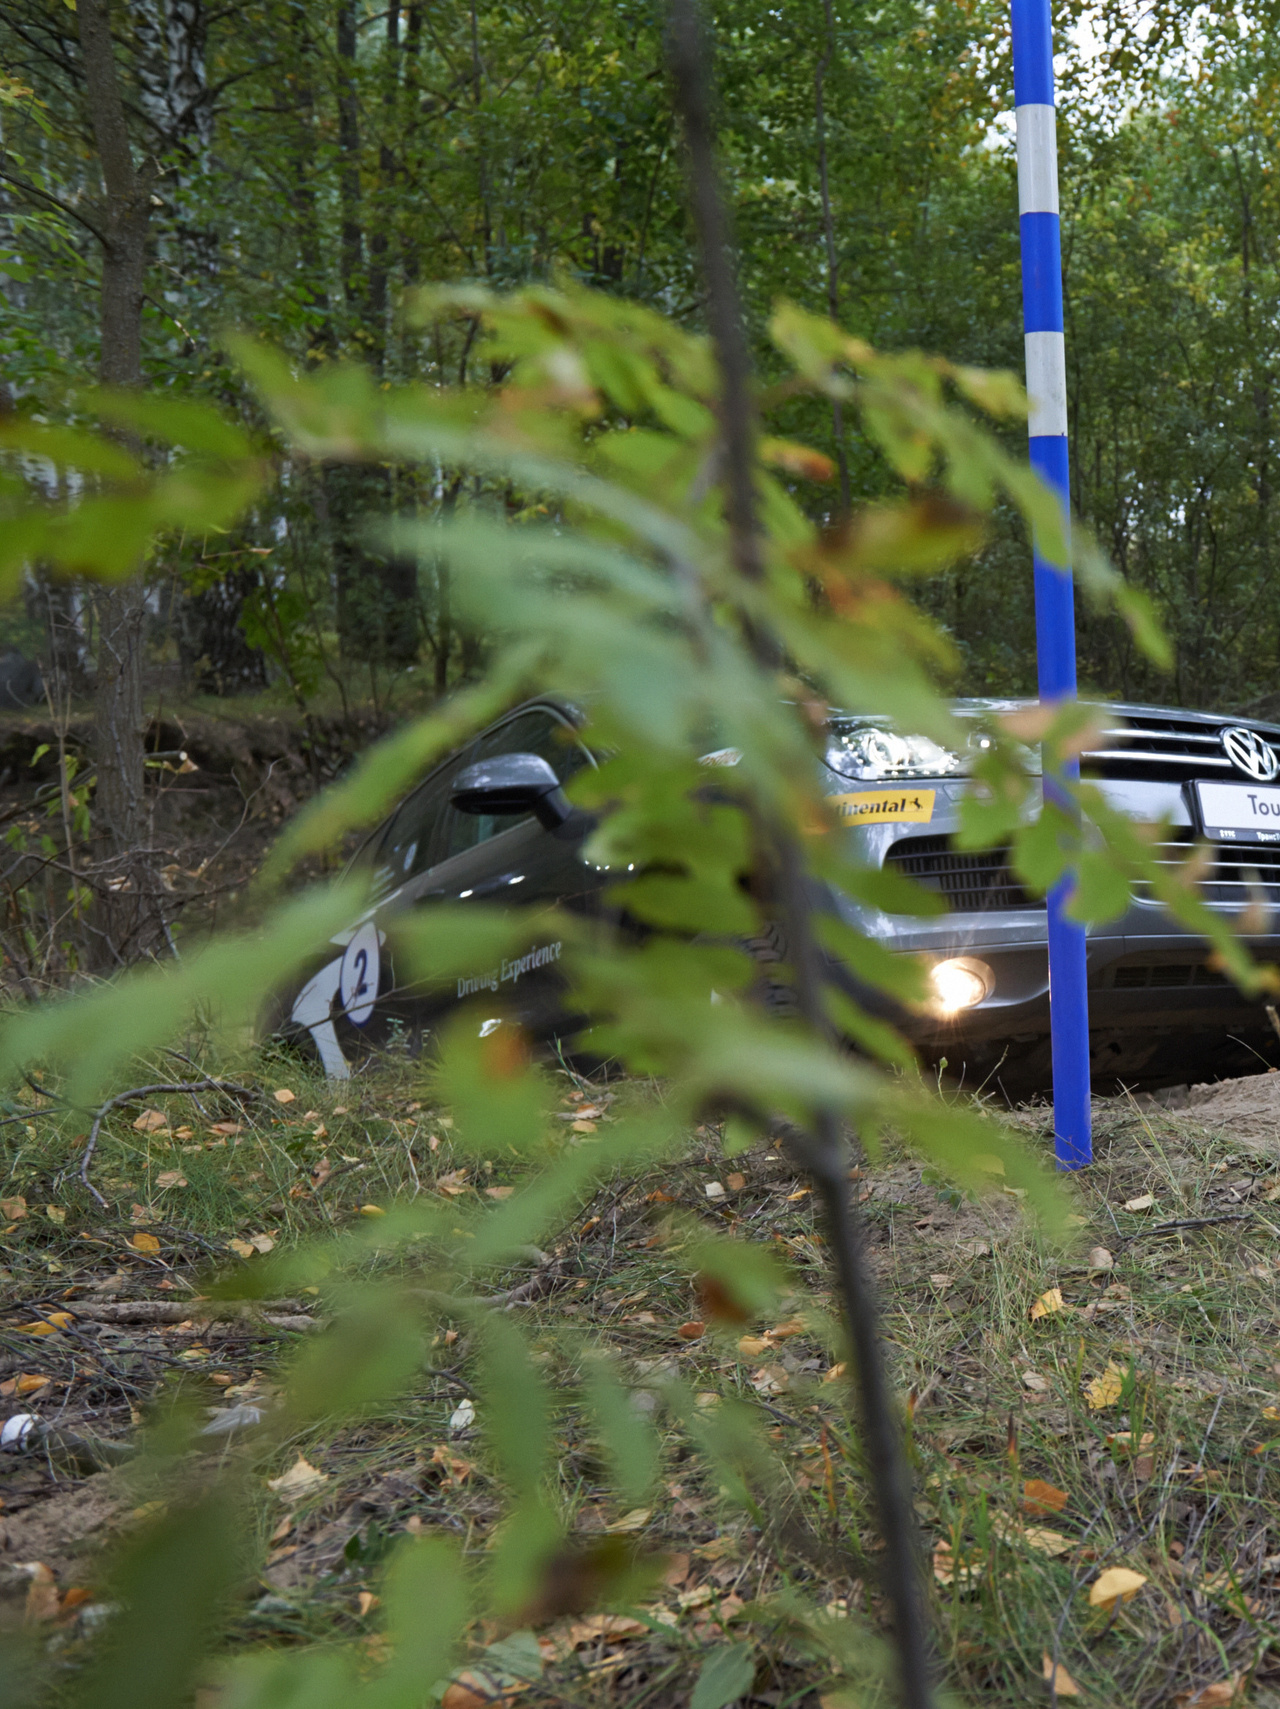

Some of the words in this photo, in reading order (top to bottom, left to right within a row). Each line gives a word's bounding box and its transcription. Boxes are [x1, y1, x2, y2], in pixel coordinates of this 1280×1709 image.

[352, 948, 368, 996] 2
[457, 967, 499, 999] Driving
[500, 941, 562, 983] Experience
